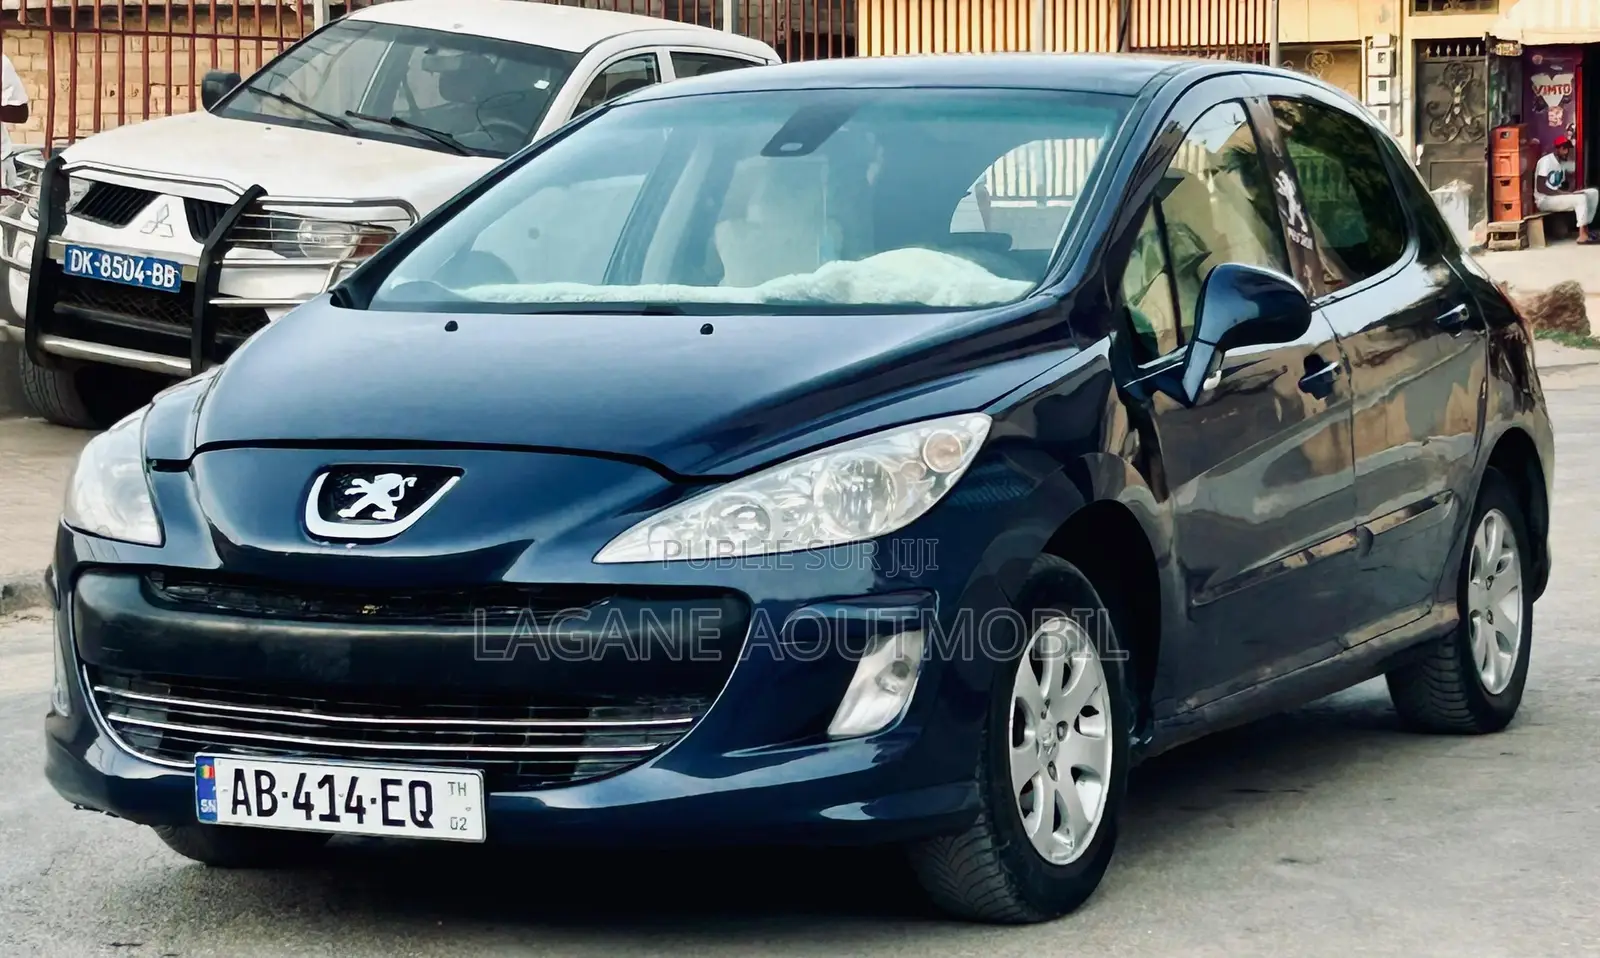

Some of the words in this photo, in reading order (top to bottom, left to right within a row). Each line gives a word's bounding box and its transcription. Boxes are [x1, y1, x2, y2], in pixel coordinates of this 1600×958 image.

[1533, 83, 1572, 96] VIMTO
[69, 248, 177, 289] DK-8504-BB
[447, 781, 467, 797] TH
[449, 816, 468, 831] 02
